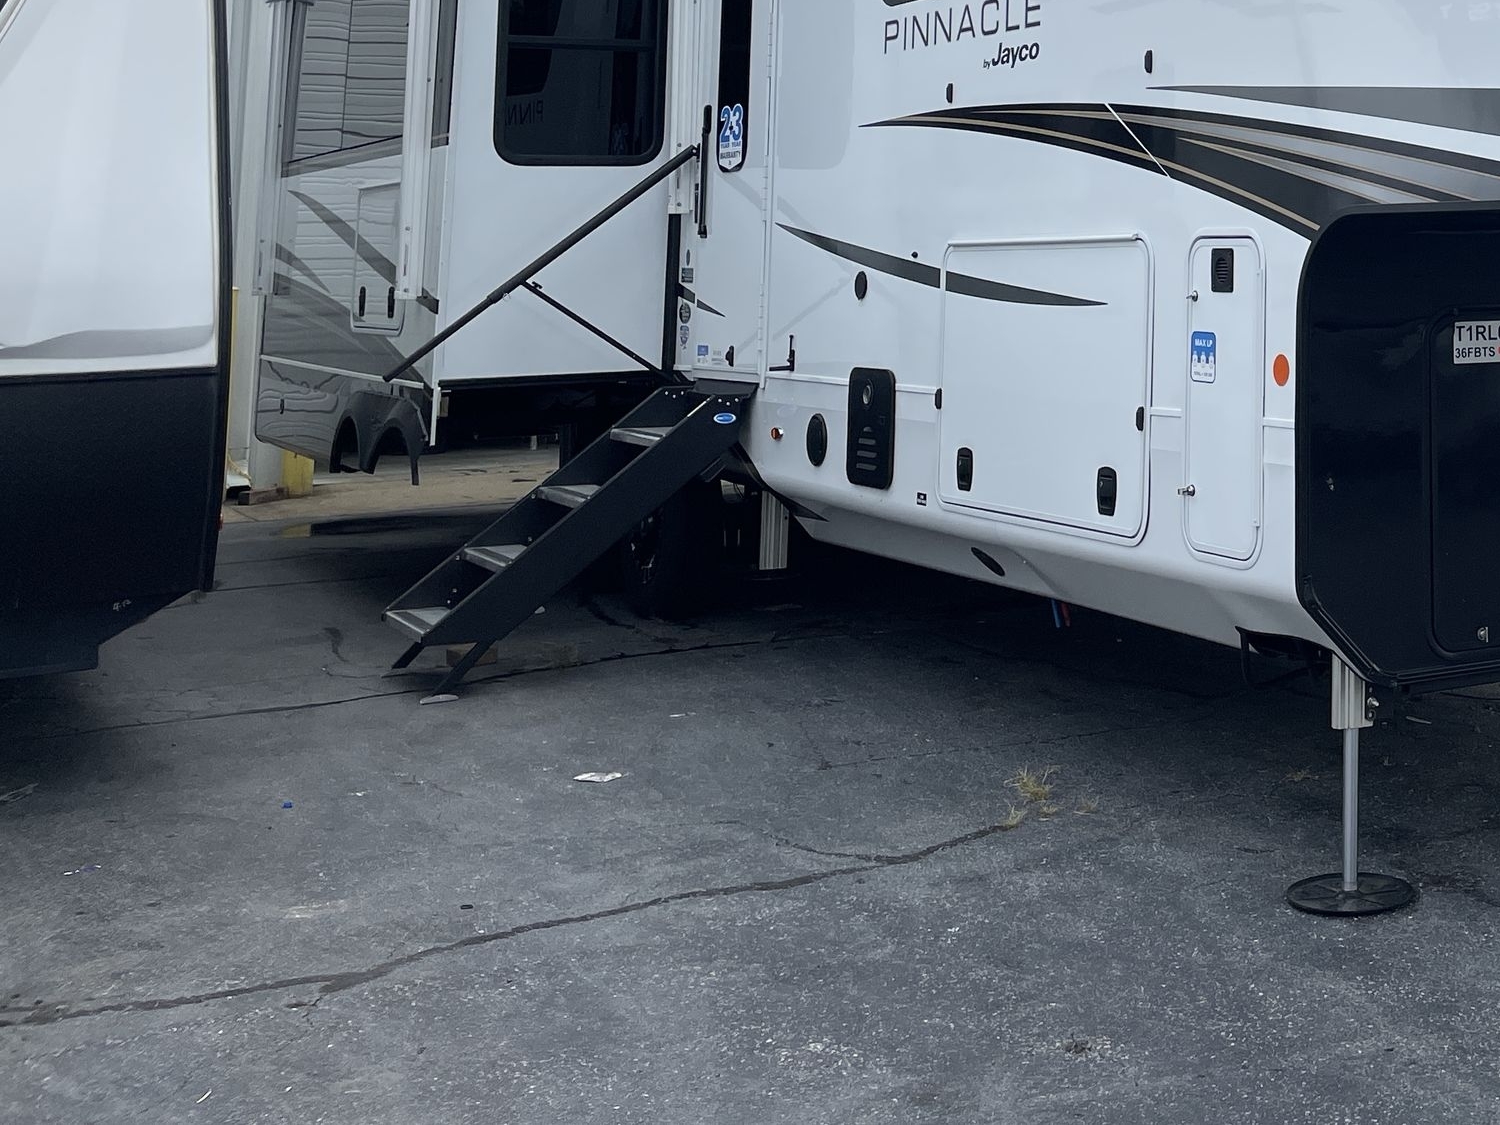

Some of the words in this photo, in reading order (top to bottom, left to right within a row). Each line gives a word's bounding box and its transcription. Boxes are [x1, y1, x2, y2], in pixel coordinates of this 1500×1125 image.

[983, 59, 991, 70] by
[991, 42, 1040, 69] Jayco
[1455, 346, 1496, 359] 36FBTS
